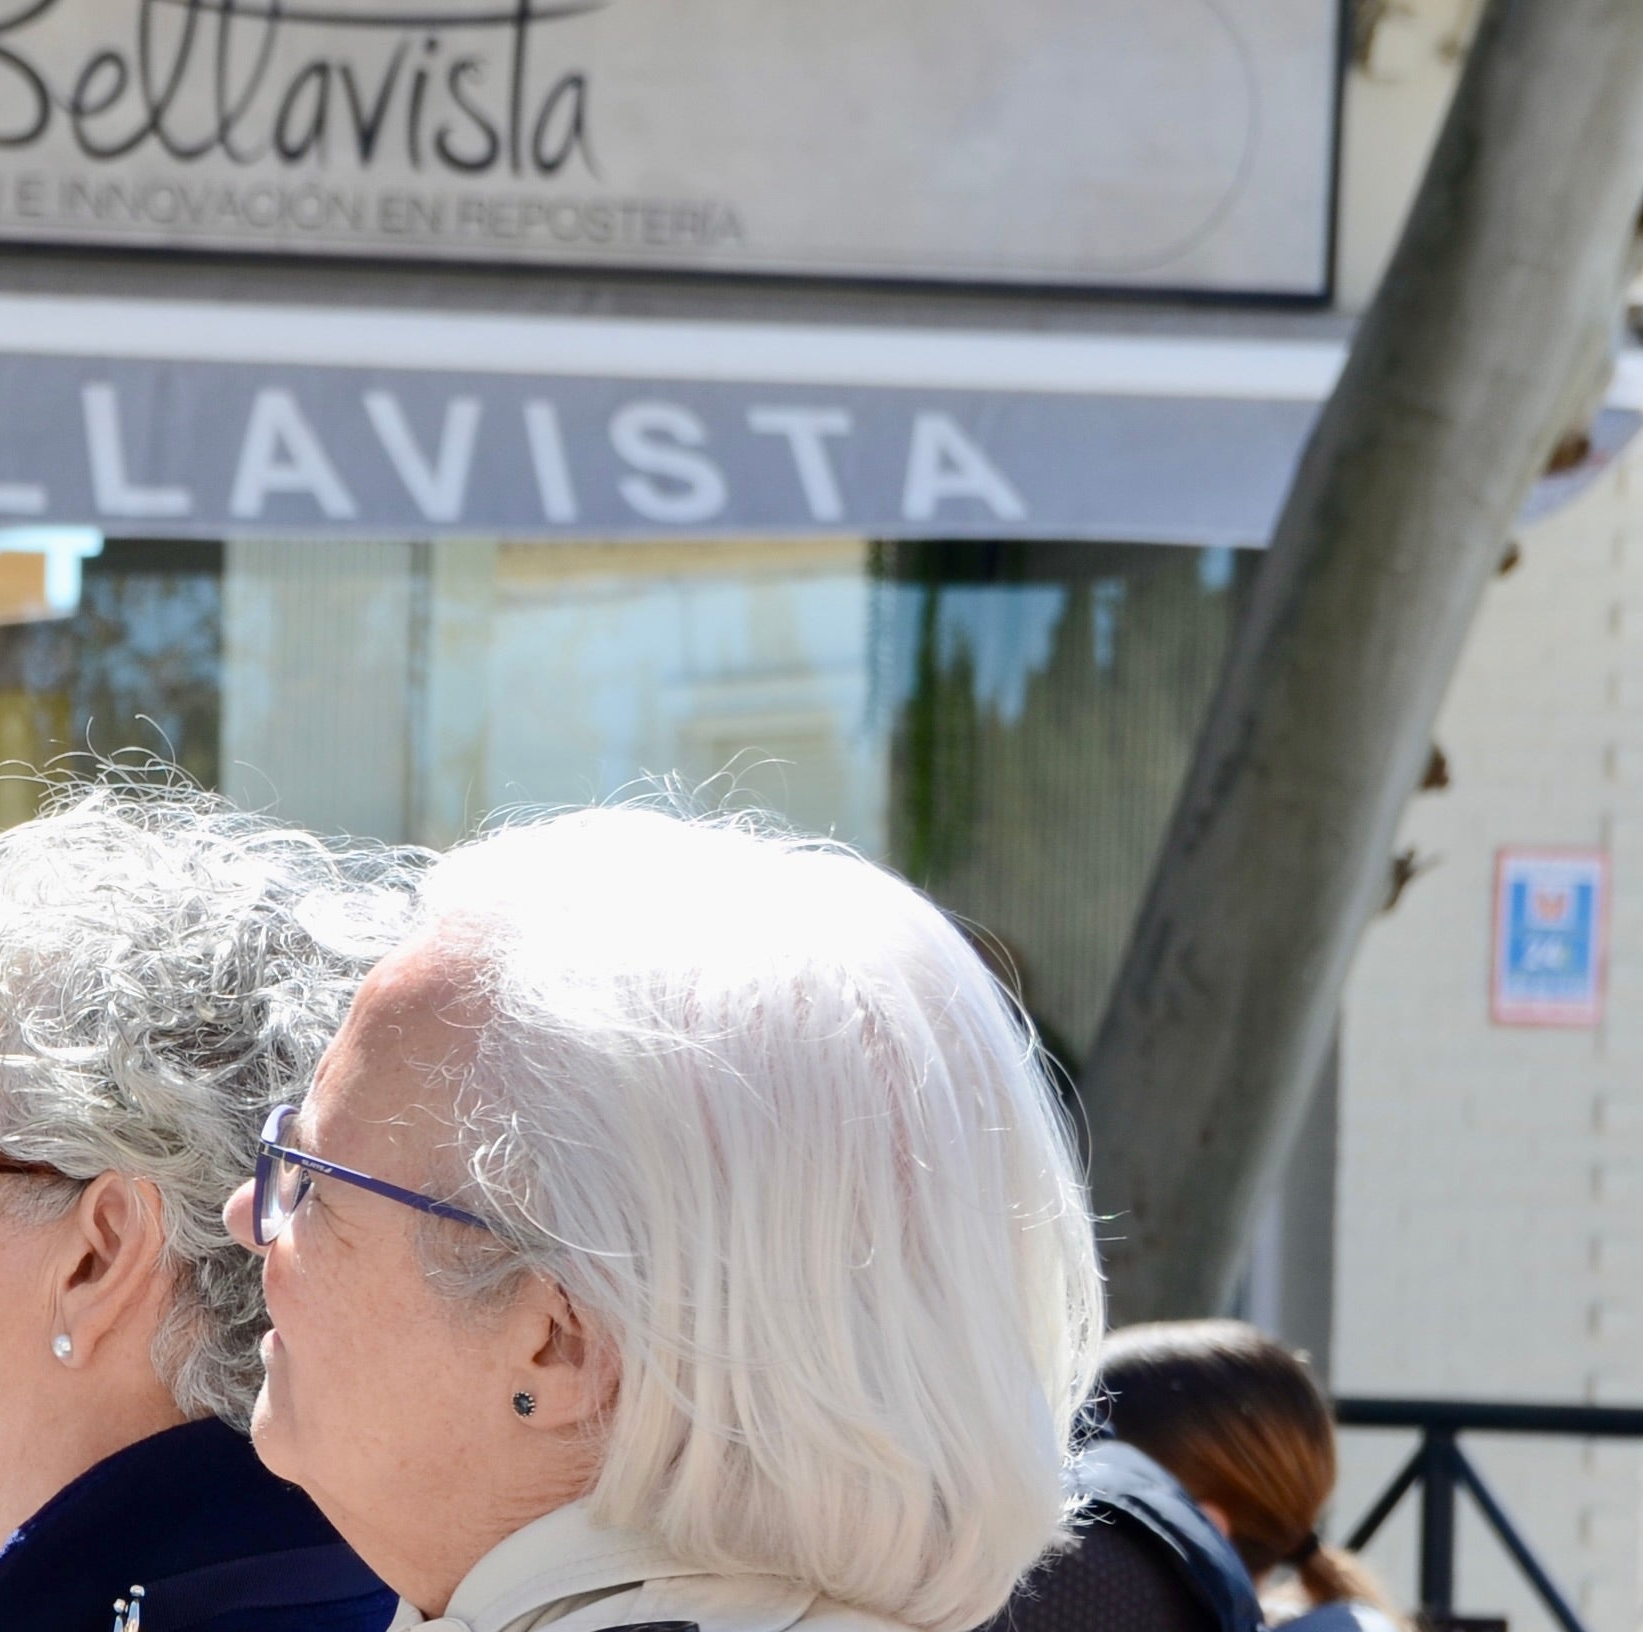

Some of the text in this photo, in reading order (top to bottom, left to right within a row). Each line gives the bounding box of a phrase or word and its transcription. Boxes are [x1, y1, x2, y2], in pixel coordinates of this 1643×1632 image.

[17, 174, 46, 218] E
[61, 174, 363, 233] INNOVACIÓN
[379, 193, 442, 236] EN
